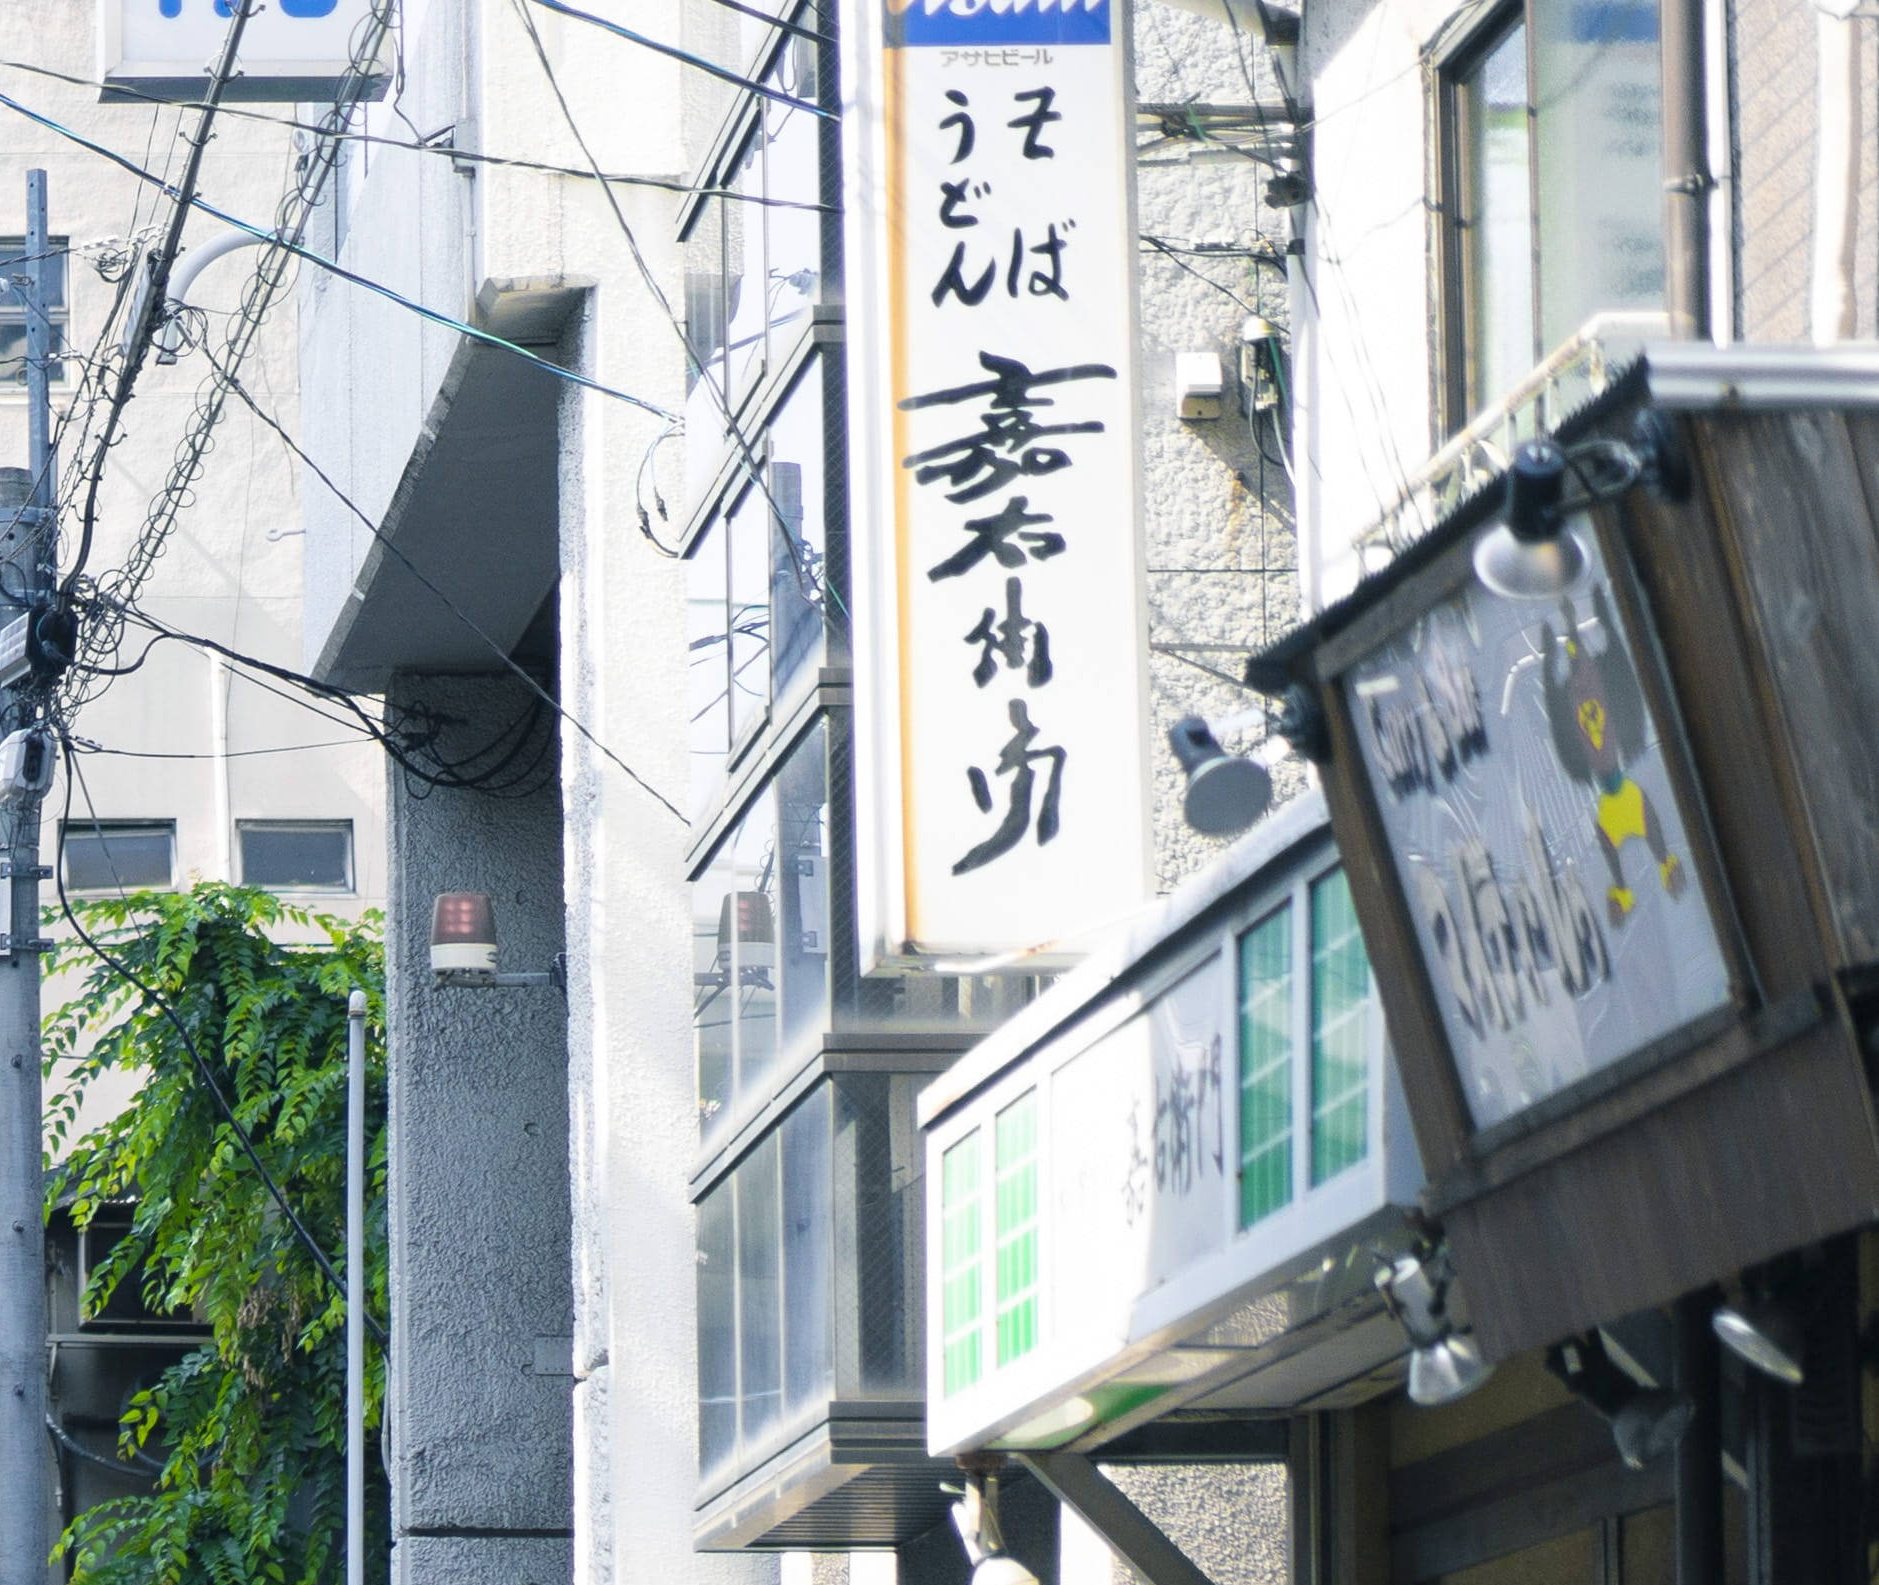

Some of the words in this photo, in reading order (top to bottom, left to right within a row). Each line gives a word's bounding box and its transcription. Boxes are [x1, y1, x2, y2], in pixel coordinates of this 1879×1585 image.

[940, 50, 1053, 67] アサヒビール
[931, 89, 995, 307] うどん
[1007, 86, 1079, 303] そば
